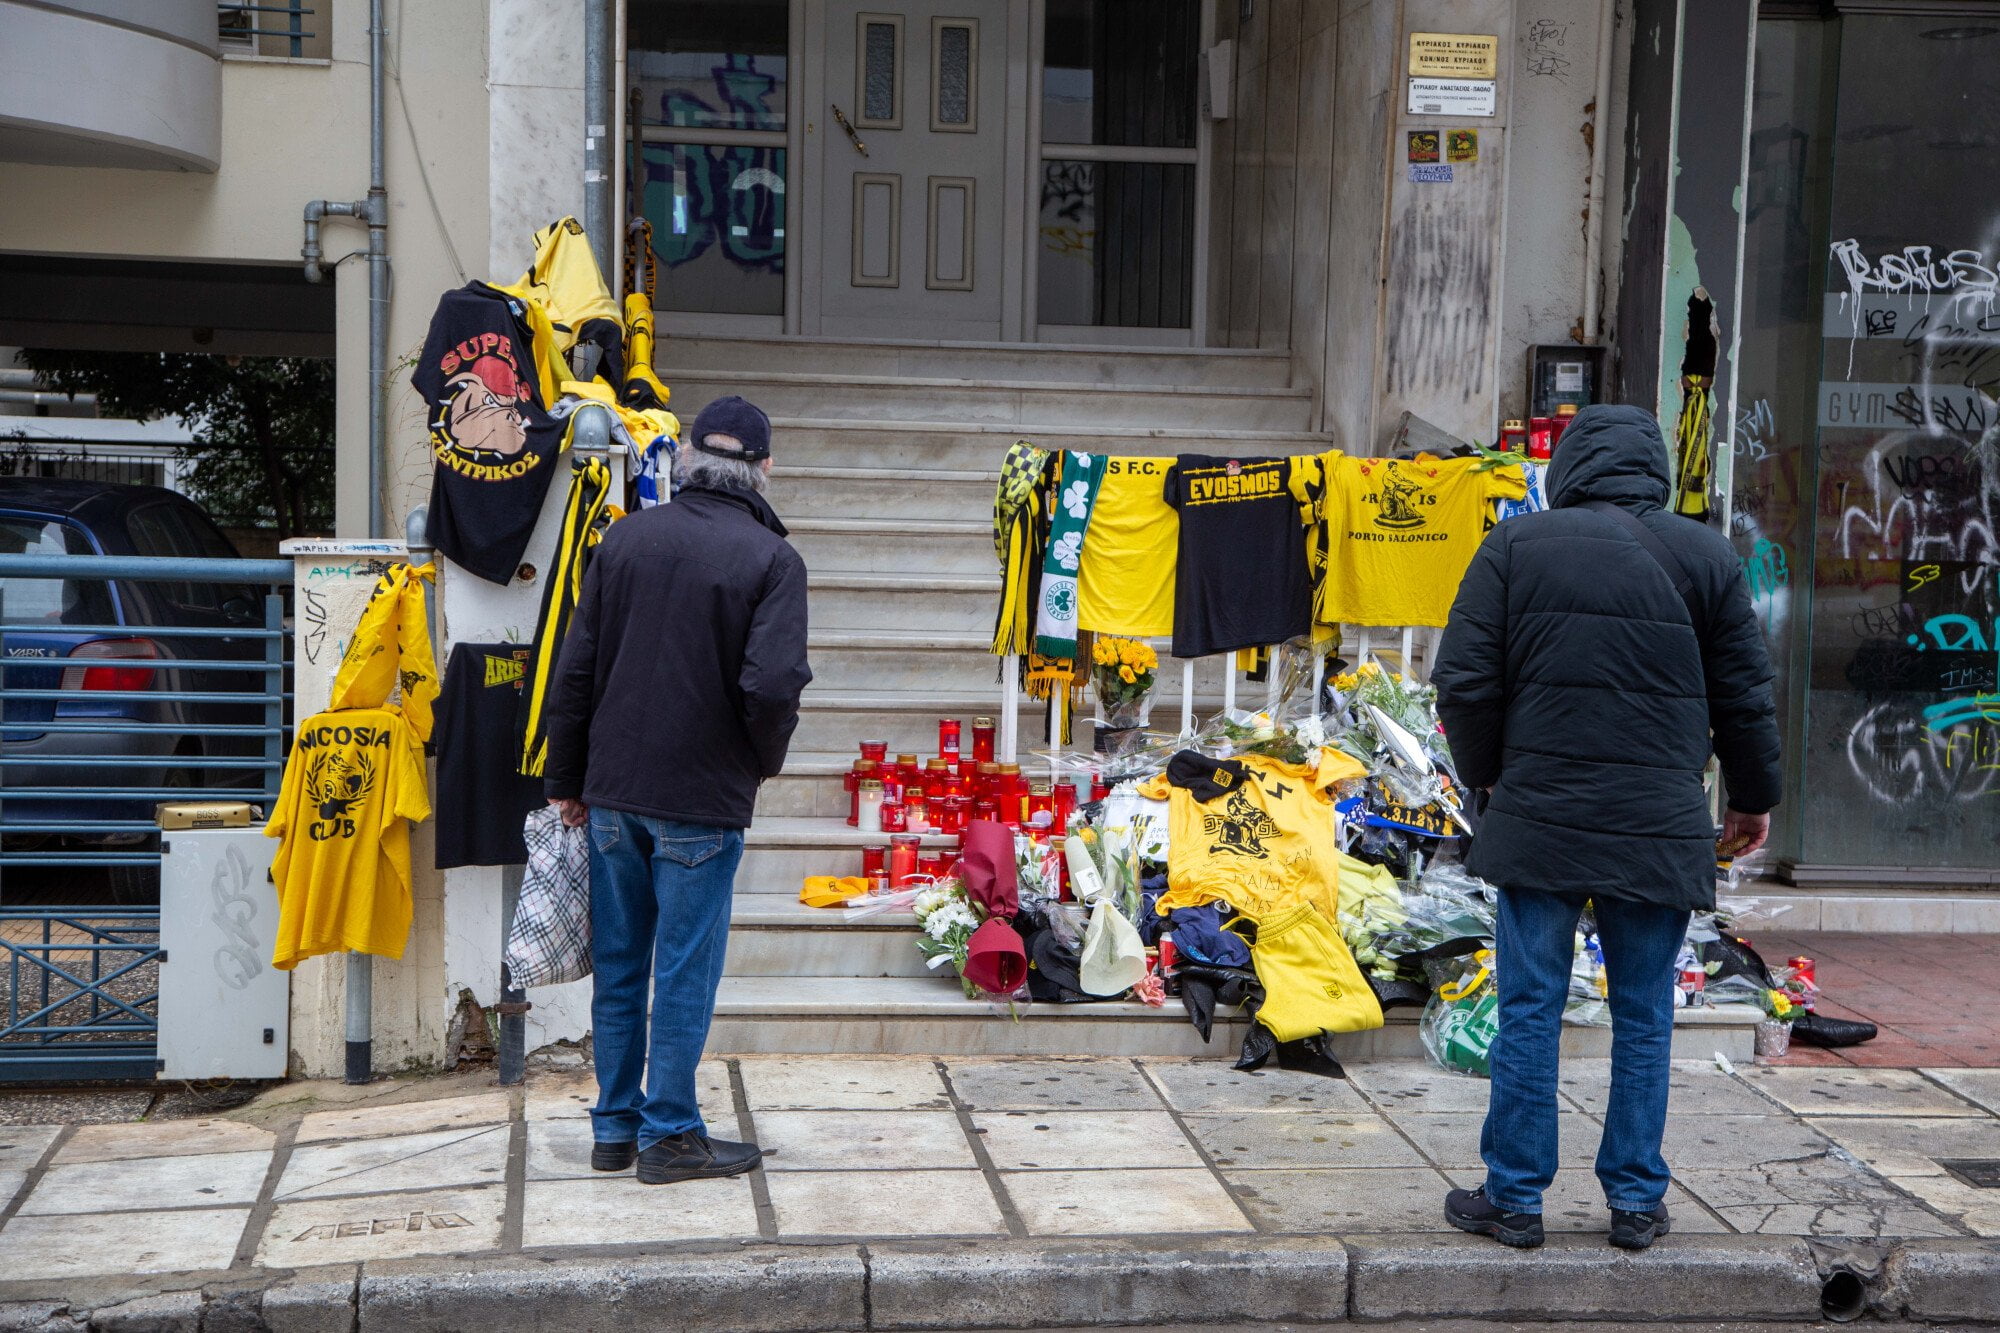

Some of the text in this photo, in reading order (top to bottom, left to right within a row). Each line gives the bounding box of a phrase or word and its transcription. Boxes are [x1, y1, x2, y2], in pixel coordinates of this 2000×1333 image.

[1128, 461, 1160, 475] F.C.
[1190, 470, 1280, 499] EVOSMOS
[1347, 530, 1448, 543] PORTO SALONICO
[8, 648, 46, 657] YARIS
[484, 656, 523, 686] ARIS
[298, 726, 391, 754] NICOSIA
[309, 818, 356, 841] CLUB
